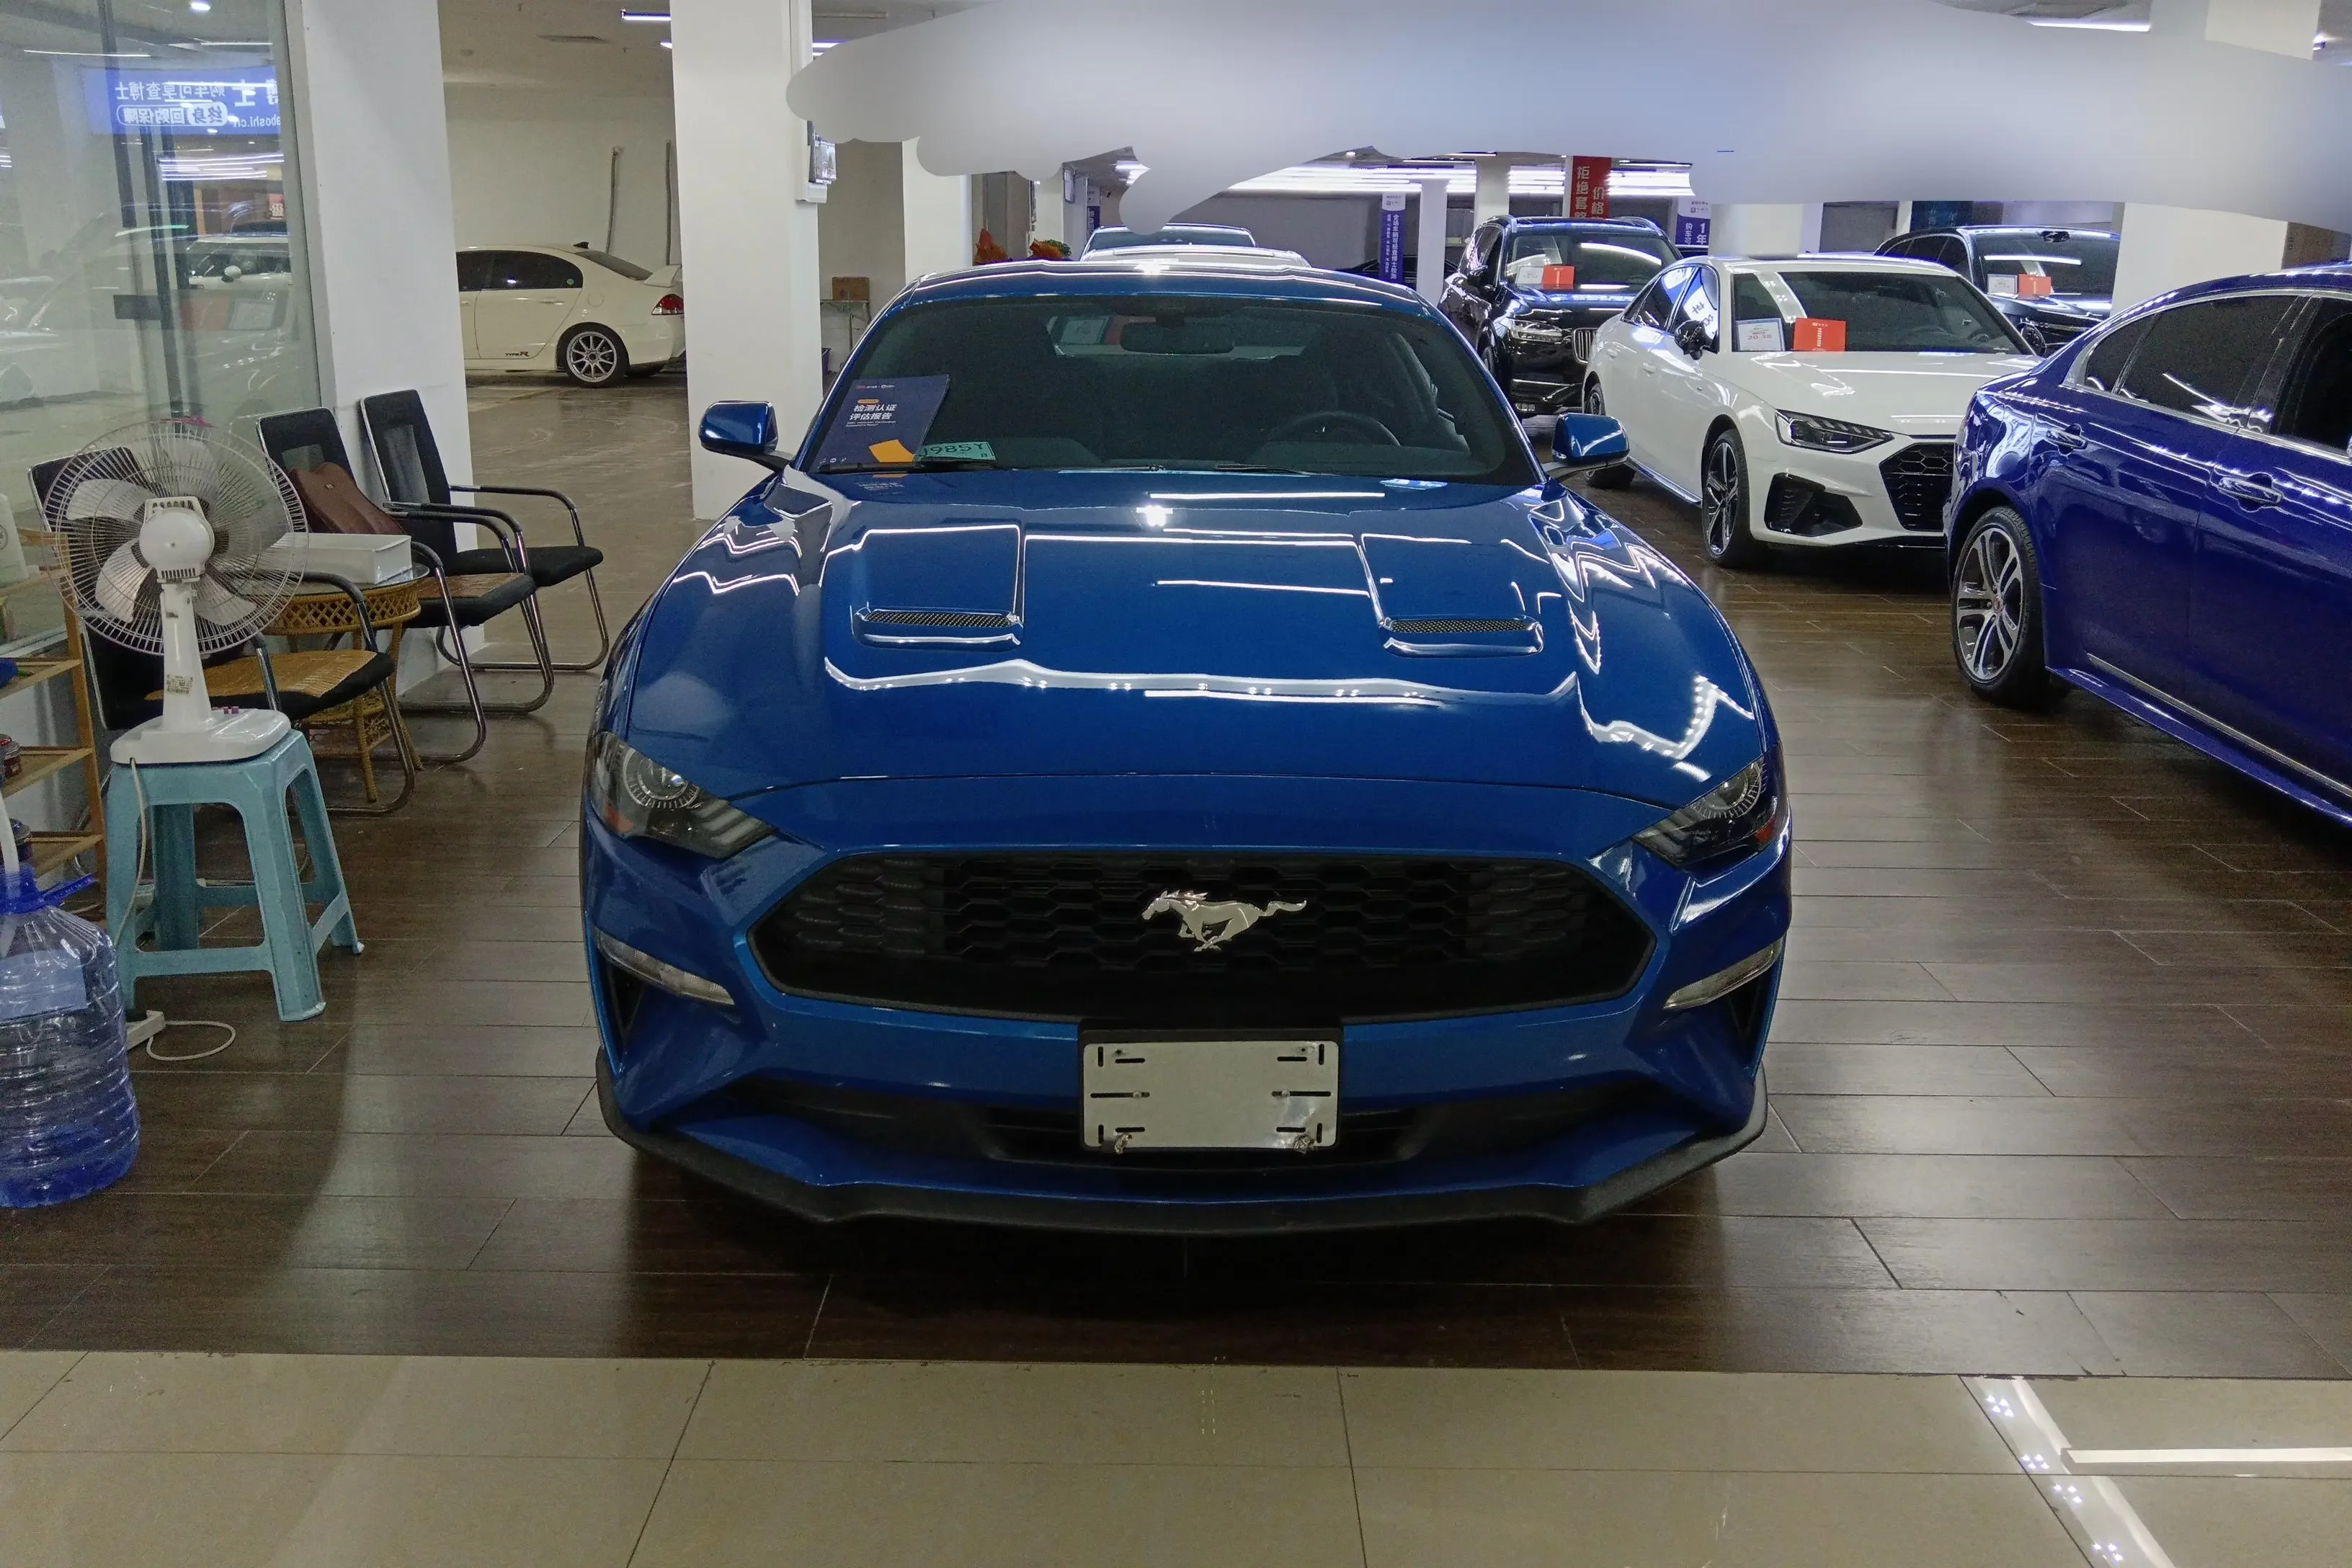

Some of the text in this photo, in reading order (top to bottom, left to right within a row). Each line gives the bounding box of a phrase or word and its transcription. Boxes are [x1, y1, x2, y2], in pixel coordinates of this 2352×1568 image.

[1591, 186, 1605, 219] 价格
[853, 404, 897, 412] 检测认证
[849, 412, 892, 421] 评估报告
